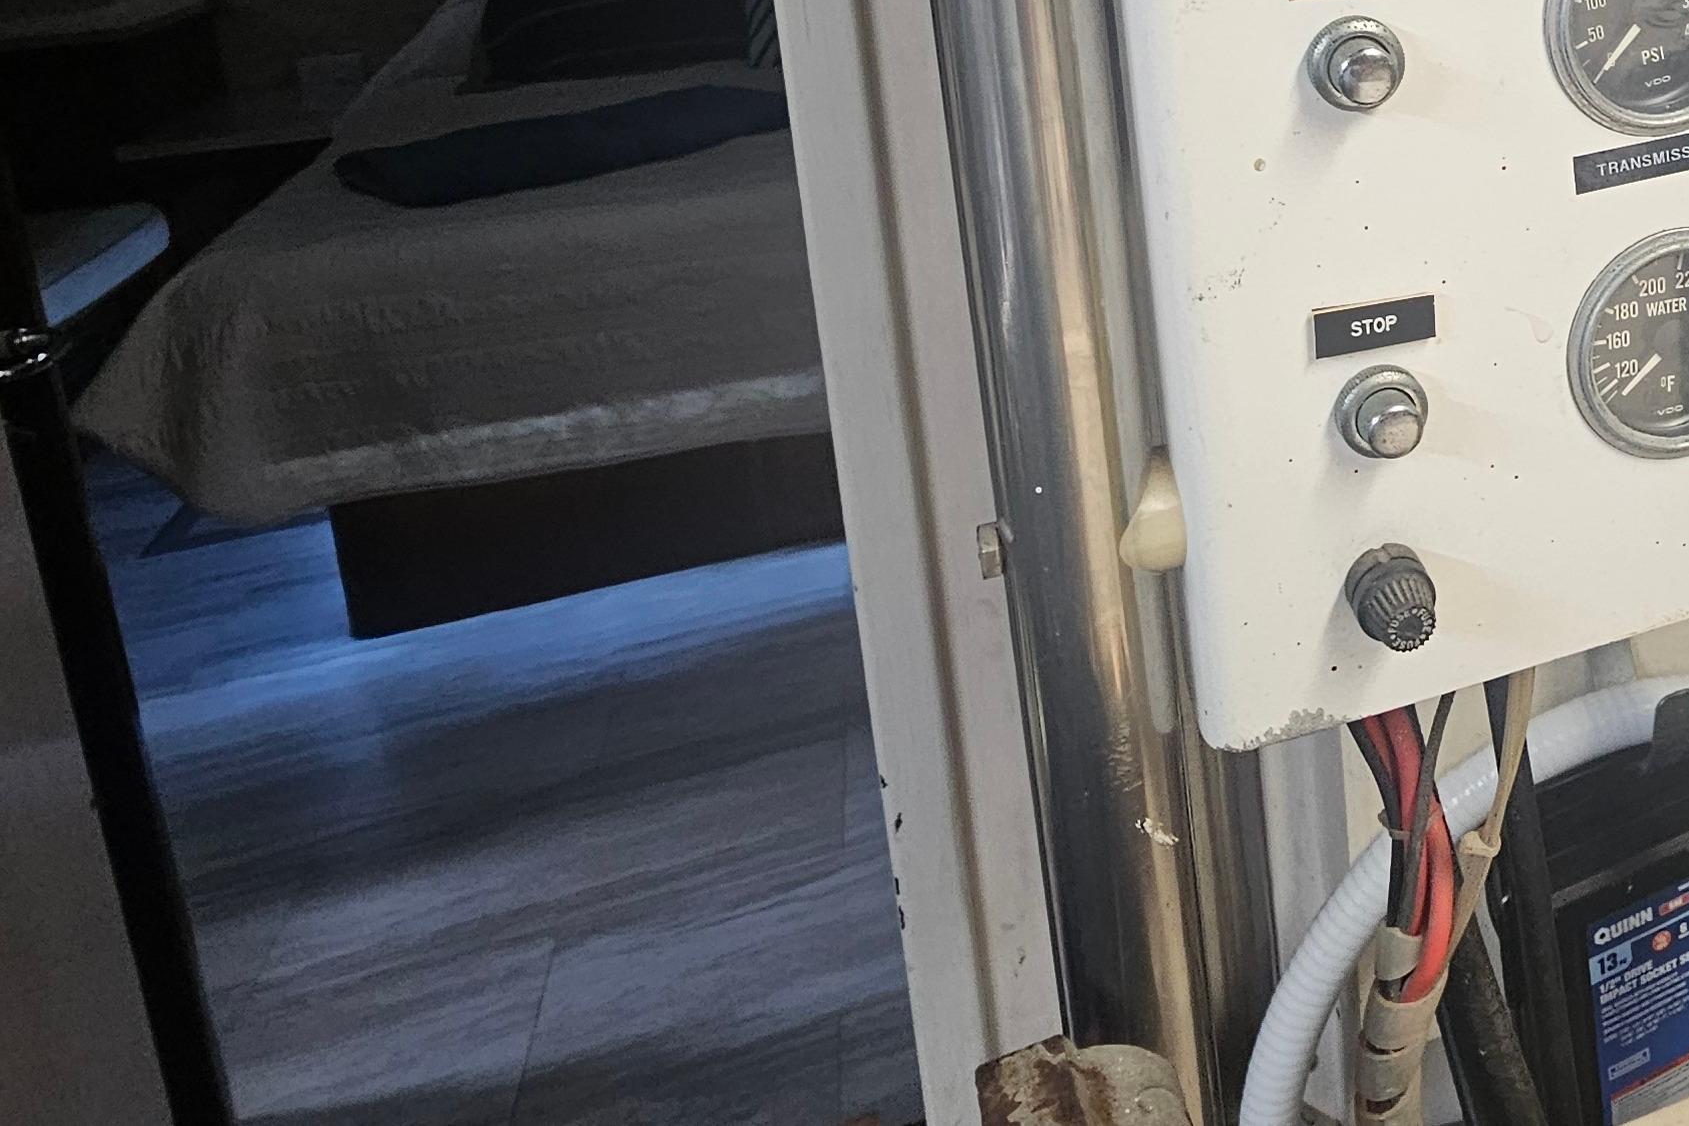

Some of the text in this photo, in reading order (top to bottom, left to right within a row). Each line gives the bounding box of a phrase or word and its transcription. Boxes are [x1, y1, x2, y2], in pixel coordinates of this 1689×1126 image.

[1587, 24, 1605, 43] 50
[1641, 45, 1665, 65] PSI
[1644, 75, 1671, 88] VDO
[1638, 276, 1666, 297] 200
[1613, 301, 1639, 321] 180
[1646, 297, 1687, 317] WATER
[1350, 314, 1398, 337] STOP
[1606, 330, 1631, 350] 160
[1614, 358, 1639, 379] 120
[1656, 404, 1684, 416] VDO
[1594, 907, 1654, 945] QUINN
[1597, 952, 1618, 974] 13
[1623, 959, 1654, 982] DRIVE
[1600, 979, 1638, 1004] IMPACT
[1640, 958, 1678, 985] SOCKET
